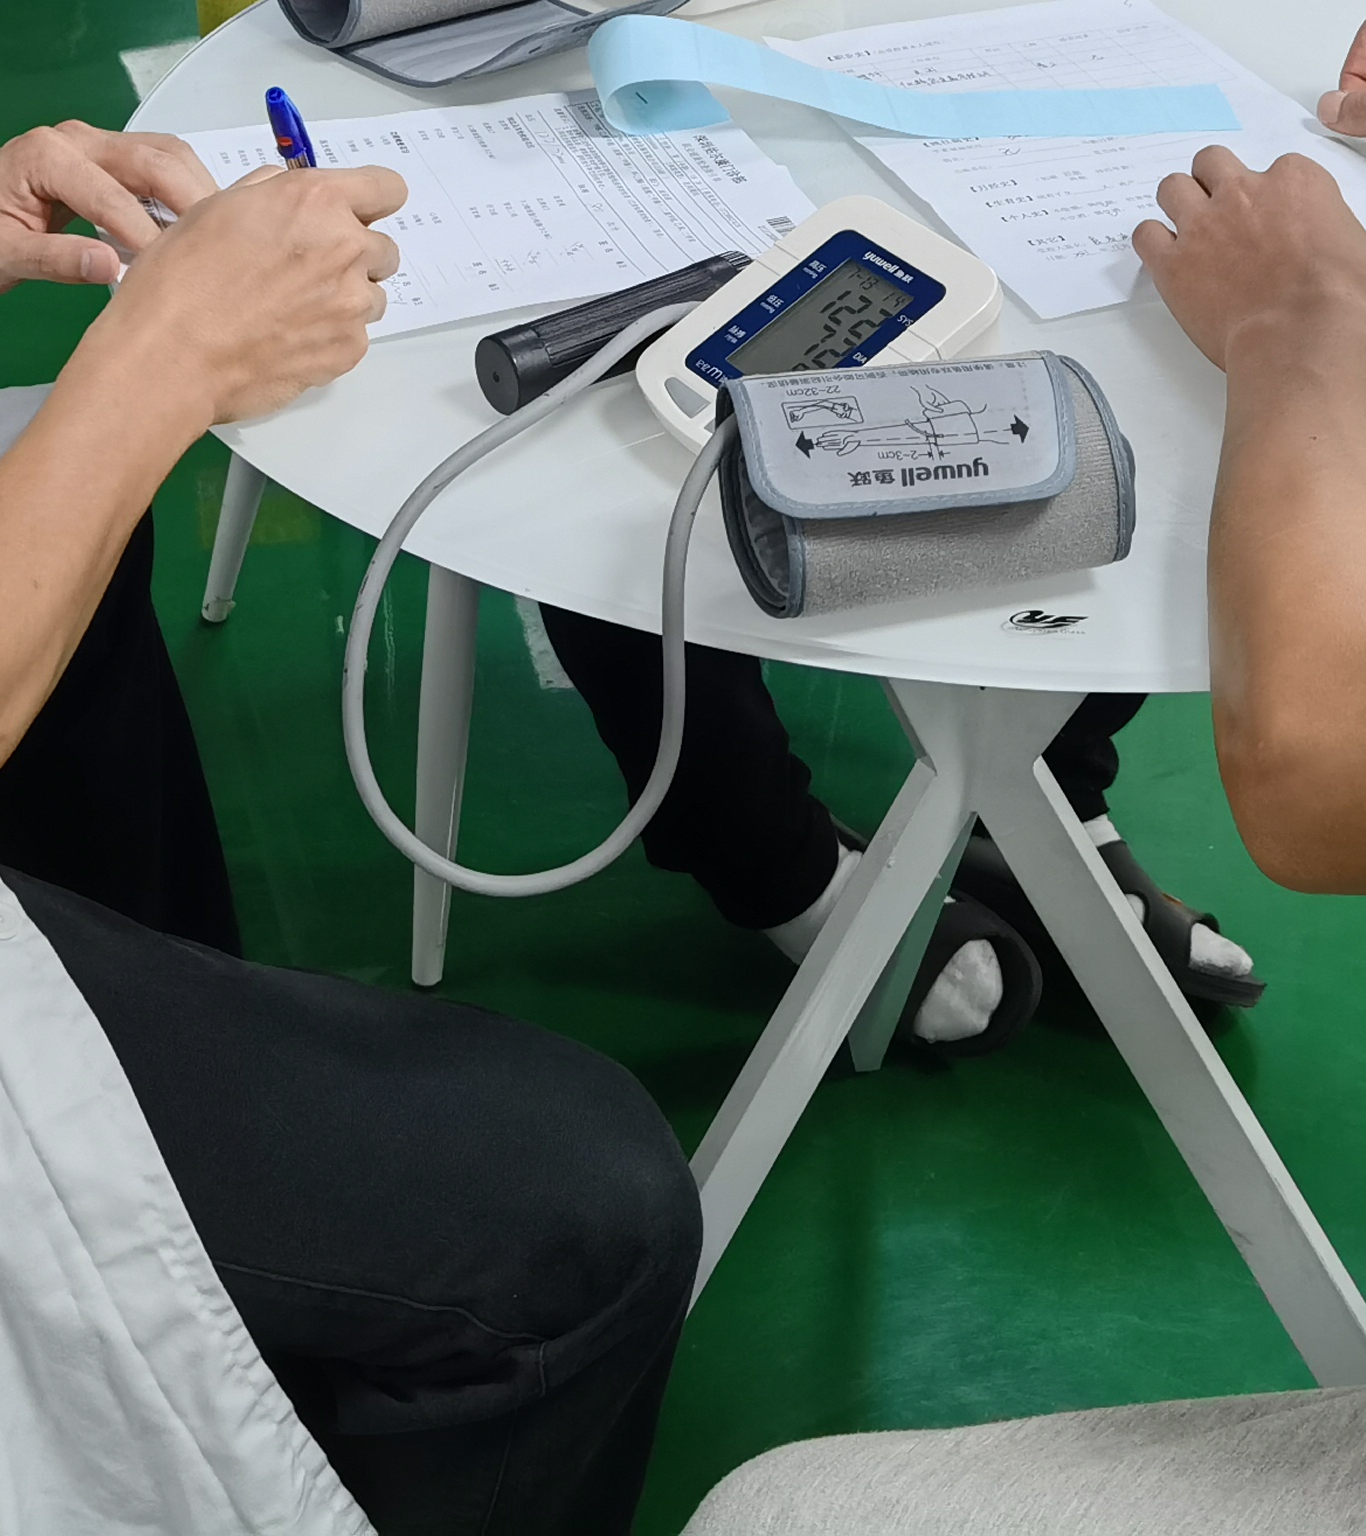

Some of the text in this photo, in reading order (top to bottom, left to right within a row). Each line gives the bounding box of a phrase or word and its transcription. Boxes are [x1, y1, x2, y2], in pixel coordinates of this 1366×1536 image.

[863, 250, 899, 276] yuwell
[897, 314, 914, 327] SYS
[852, 351, 868, 365] DIA
[846, 457, 989, 487] yuwell 鱼跃
